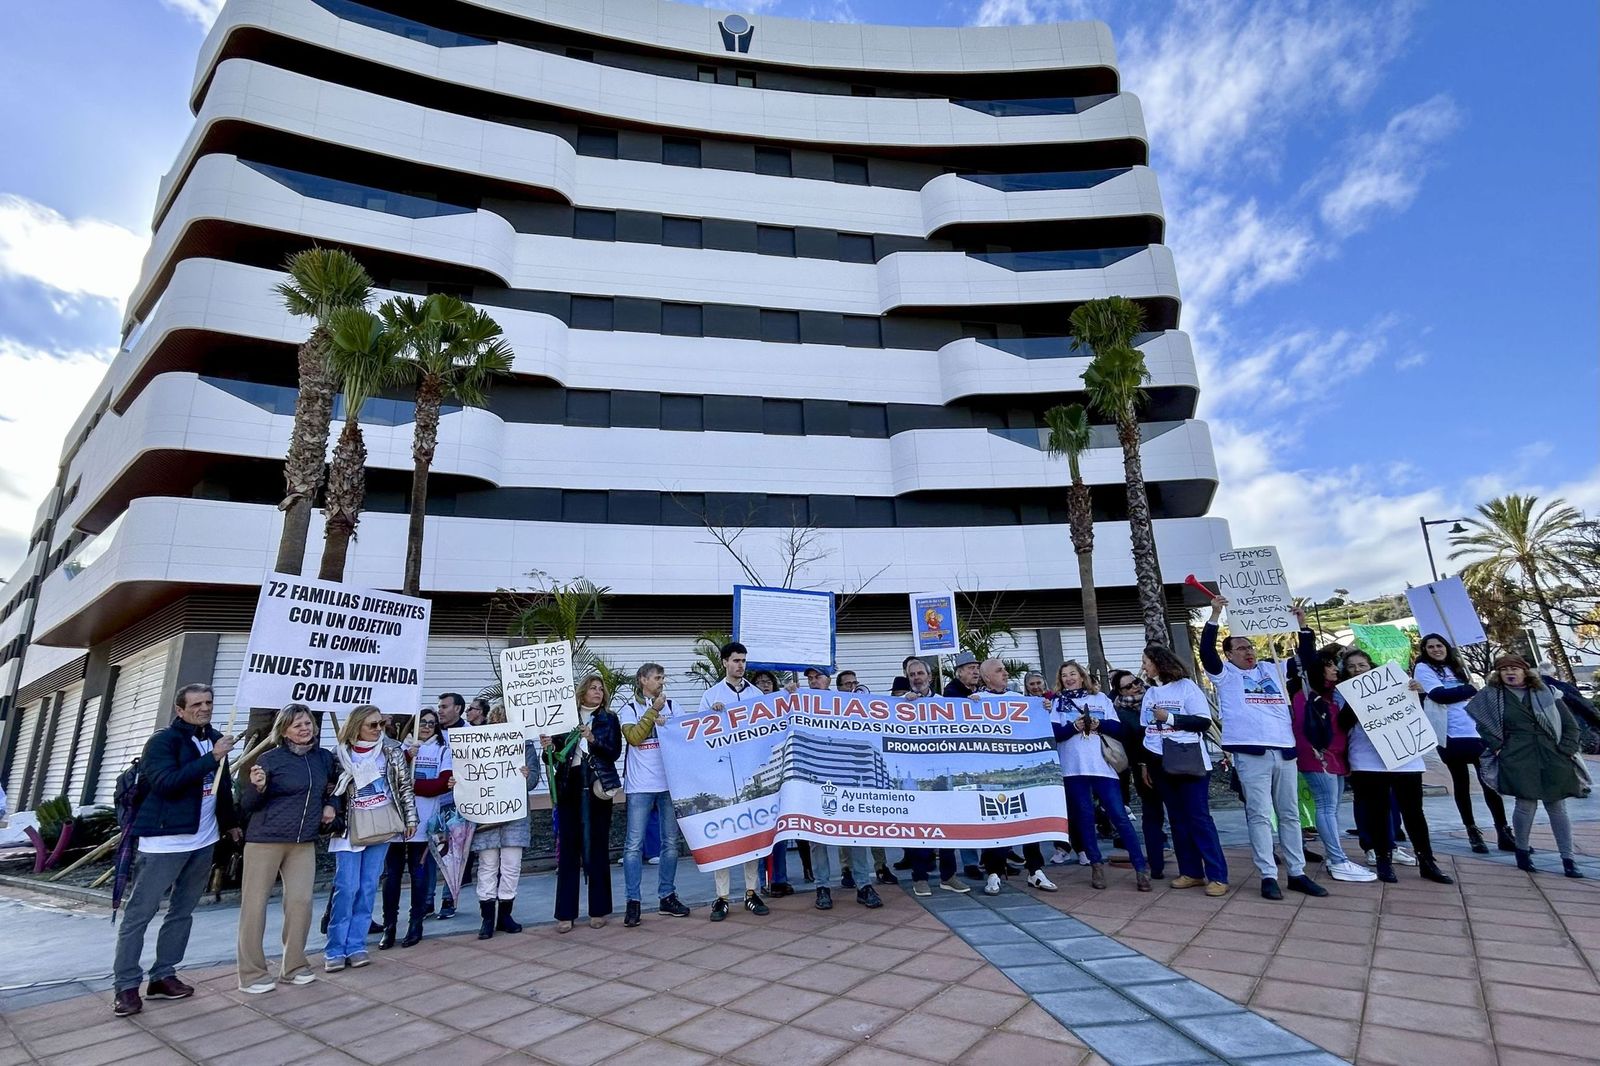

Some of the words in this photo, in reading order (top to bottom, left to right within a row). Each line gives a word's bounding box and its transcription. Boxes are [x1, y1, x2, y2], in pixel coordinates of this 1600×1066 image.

[1219, 549, 1272, 561] ESTAMOS
[1240, 560, 1256, 568] DE
[1219, 568, 1287, 589] ALQUILER
[268, 581, 288, 598] 72
[290, 584, 361, 610] FAMILIAS
[361, 596, 425, 620] DIFERENTES
[289, 607, 324, 625] CON
[325, 612, 347, 629] UN
[348, 616, 401, 636] OBJETIVO
[1240, 615, 1289, 631] VACÍOS
[309, 632, 329, 648] EN
[330, 634, 381, 654] COMÚN:
[505, 644, 565, 661] NUESTRAS
[248, 653, 345, 680] !!NUESTRA
[349, 663, 418, 685] VIVIENDA
[510, 658, 566, 673] ILUSIONES
[518, 669, 554, 679] ESTÁN
[506, 675, 565, 691] APAGADAS
[1352, 667, 1402, 699] 2021
[291, 682, 331, 702] CON
[332, 685, 373, 704] LUZ!!
[508, 685, 575, 708] NECESITAMOS
[522, 704, 564, 728] LUZ
[1366, 703, 1383, 713] AL
[681, 715, 723, 741] 72
[728, 694, 890, 729] FAMILIAS
[896, 702, 954, 722] SIN
[963, 702, 1029, 722] LUZ
[449, 732, 492, 743] ESTEPONA
[493, 731, 524, 741] AVANZA
[706, 721, 788, 749] VIVIENDAS
[789, 715, 882, 732] TERMINADAS
[884, 724, 906, 734] NO
[909, 724, 1012, 735] ENTREGADAS
[1383, 717, 1435, 760] LUZ
[452, 745, 470, 759] AQUÍ
[472, 746, 491, 760] NOS
[493, 743, 524, 758] APAGAN
[887, 740, 957, 752] PROMOCIÓN
[958, 742, 990, 751] ALMA
[992, 741, 1051, 752] ESTEPONA
[464, 761, 517, 781] BASTA
[480, 786, 495, 797] DE
[841, 789, 915, 802] Ayuntamiento
[460, 799, 522, 816] OSCURIDAD
[842, 803, 855, 813] de
[858, 803, 909, 816] Estepona
[704, 798, 781, 839] endes
[981, 813, 1029, 822] LEVEL
[814, 821, 915, 838] SOLUCIÓN
[918, 827, 946, 838] YA
